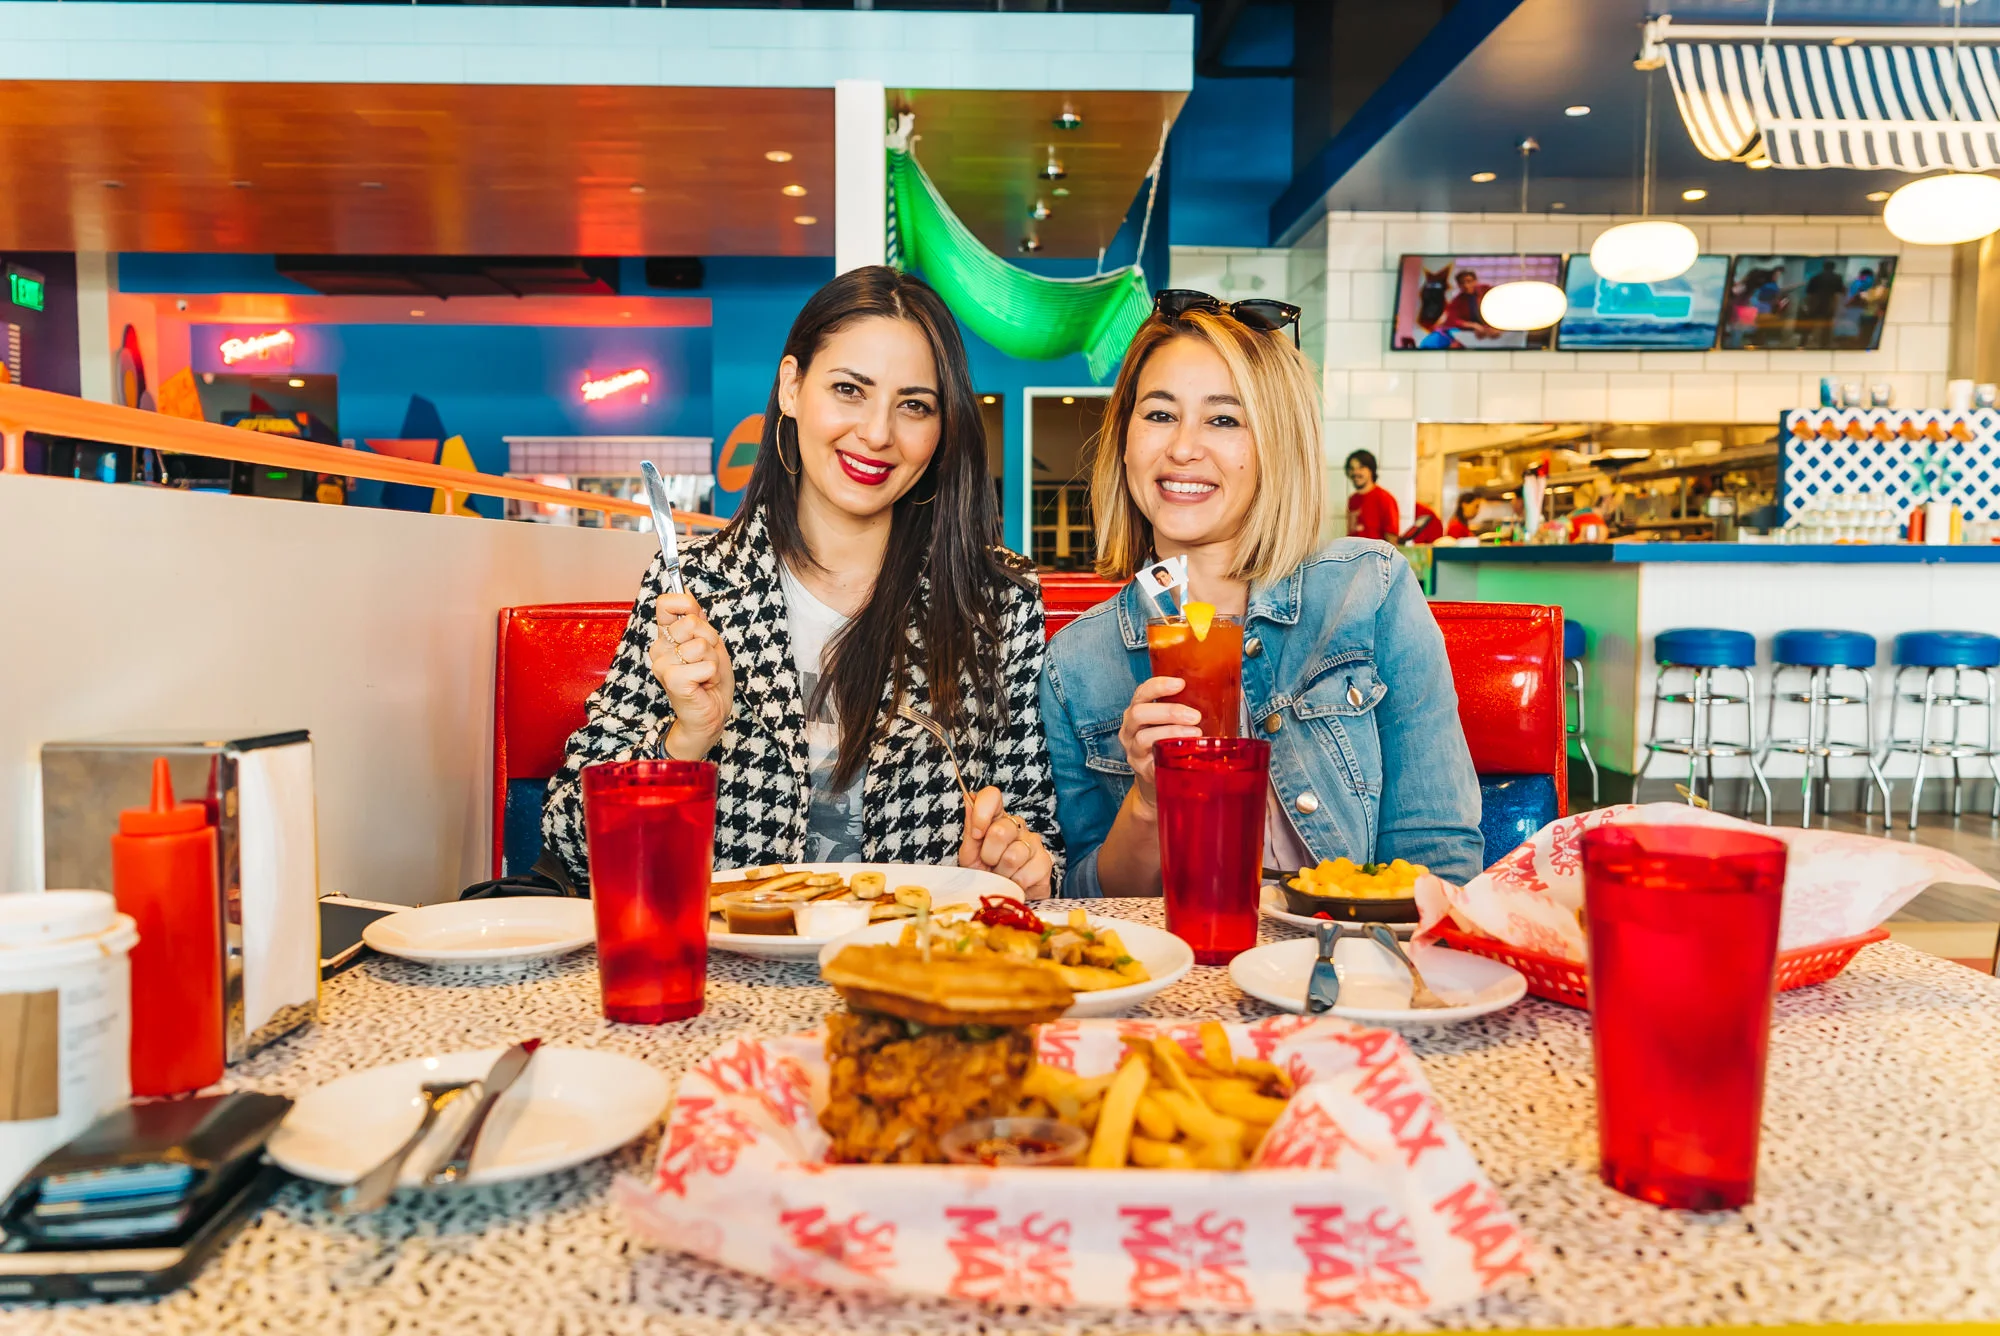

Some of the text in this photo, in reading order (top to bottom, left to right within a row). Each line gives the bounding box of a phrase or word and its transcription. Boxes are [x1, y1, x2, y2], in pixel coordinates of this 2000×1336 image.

[1549, 824, 1575, 877] SAVED
[1293, 1205, 1361, 1314] MAX
[1432, 1181, 1533, 1287] MAX
